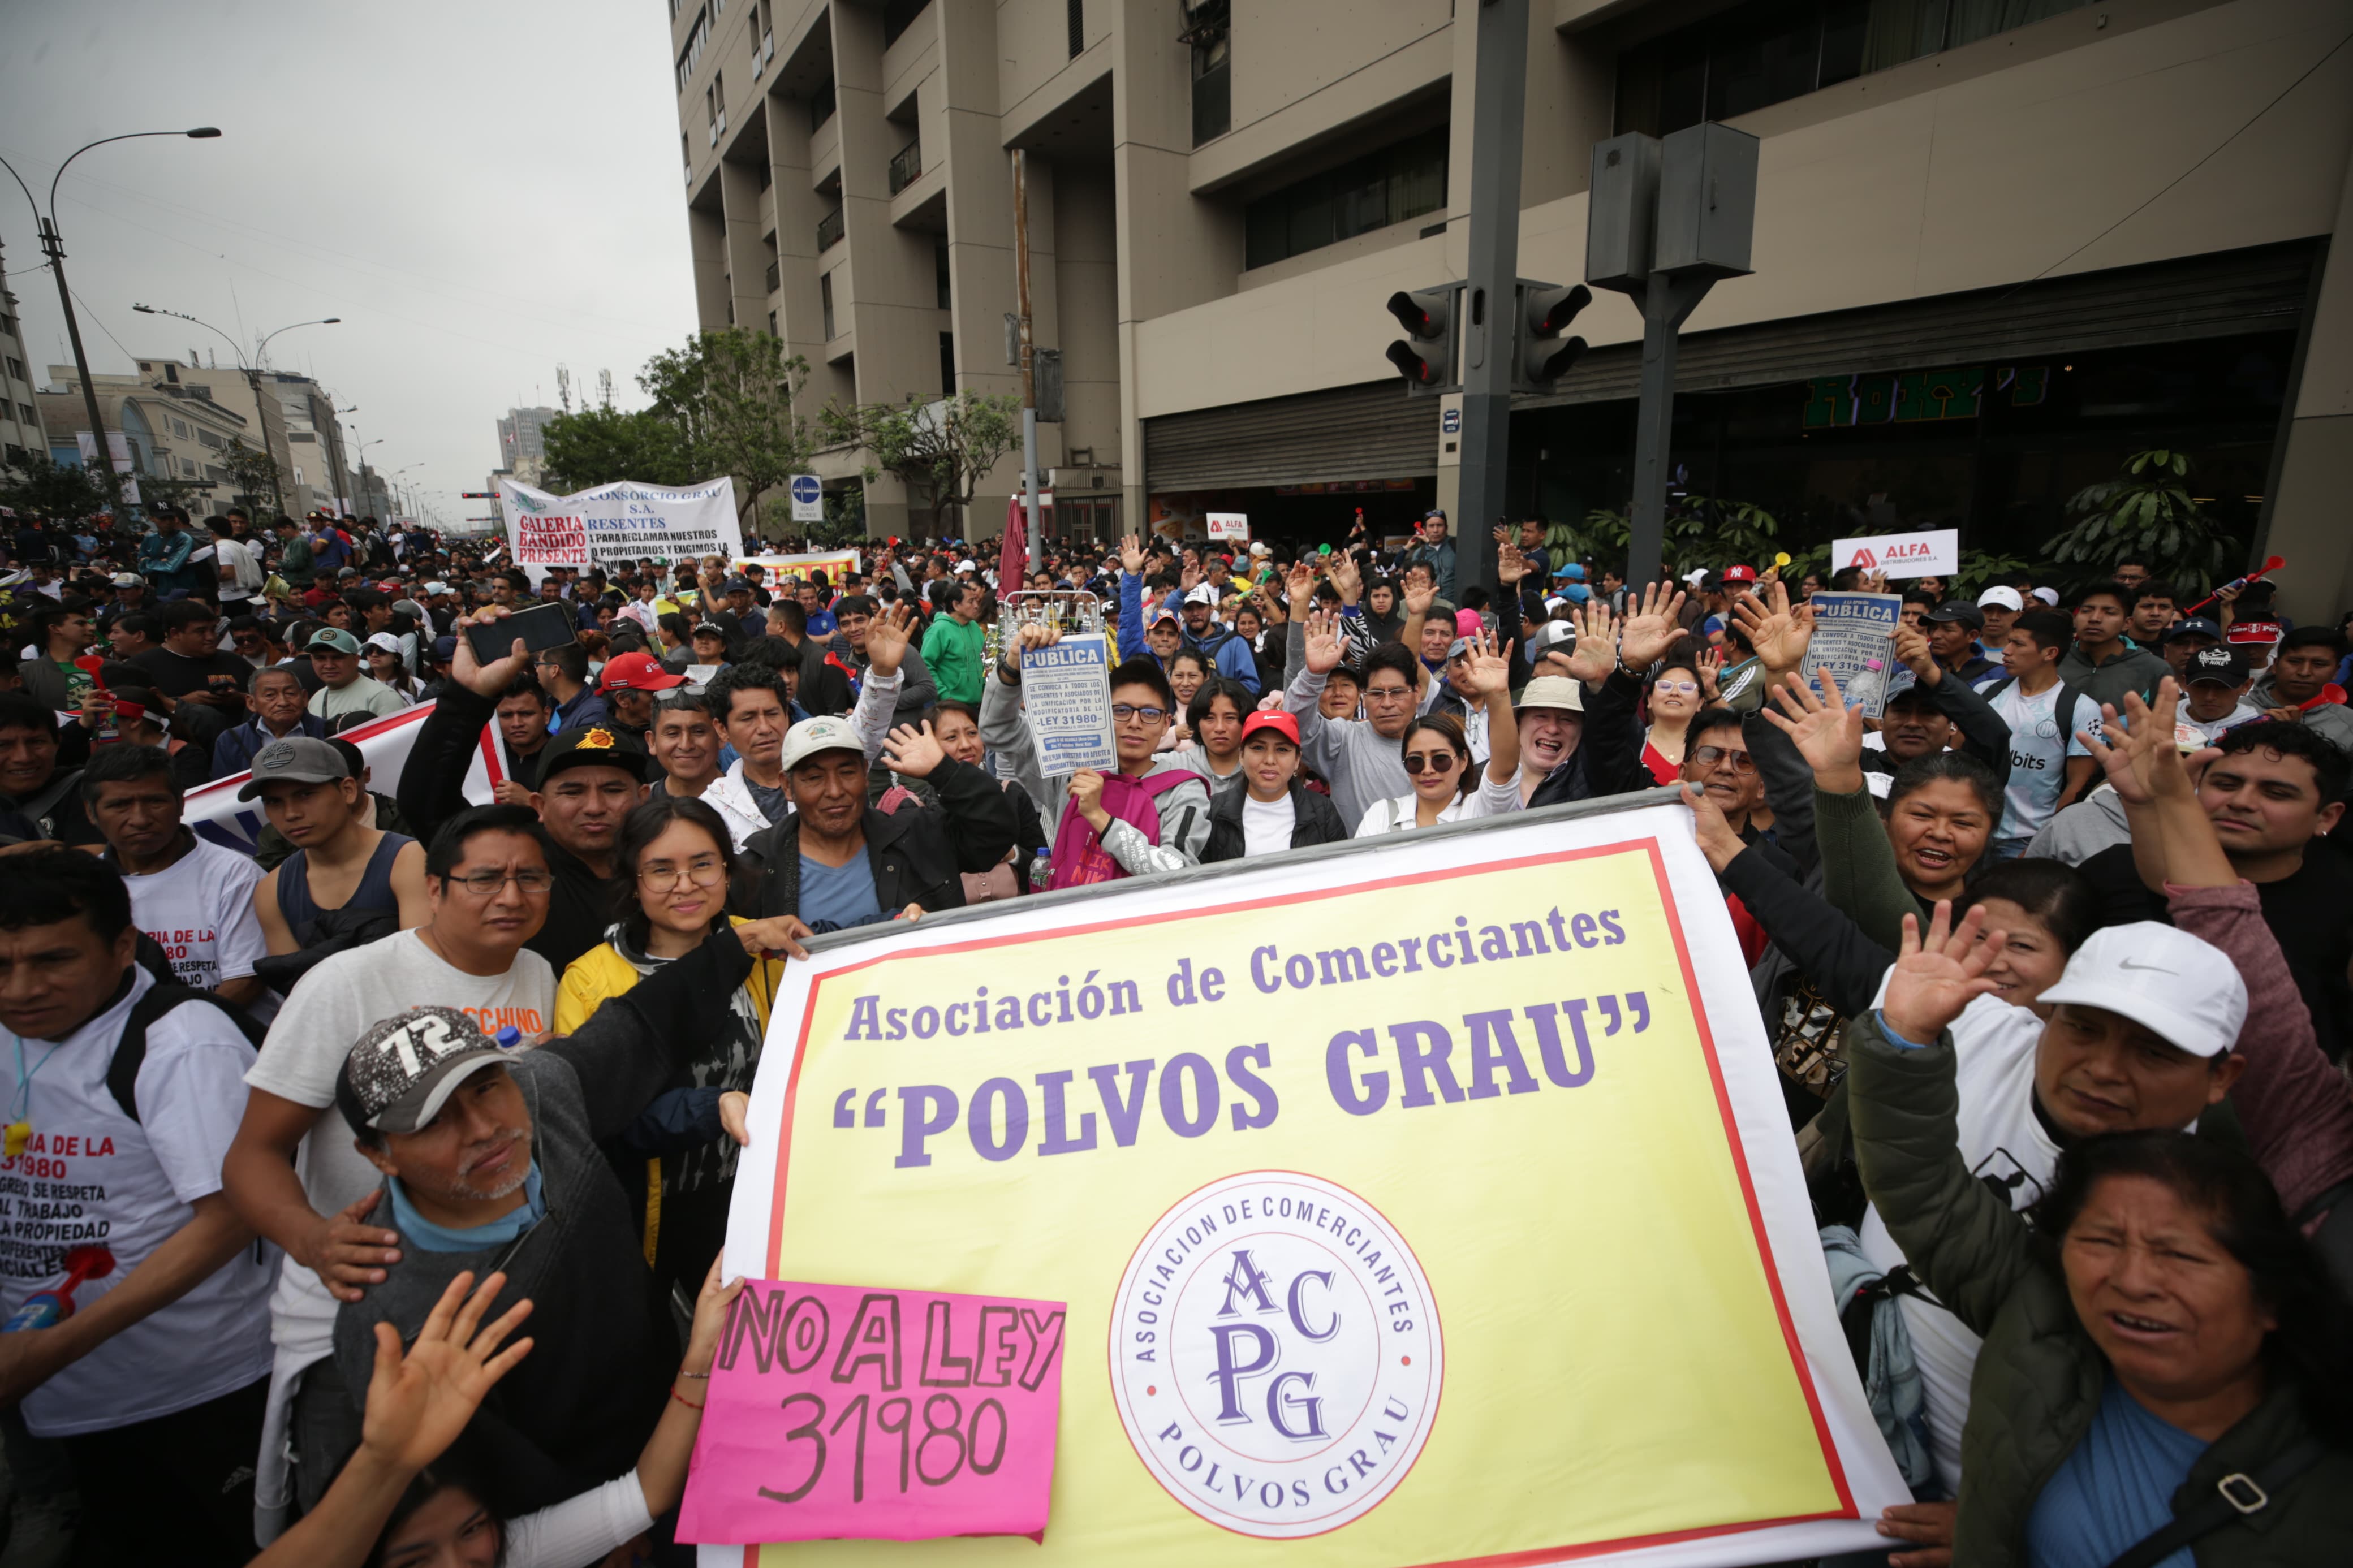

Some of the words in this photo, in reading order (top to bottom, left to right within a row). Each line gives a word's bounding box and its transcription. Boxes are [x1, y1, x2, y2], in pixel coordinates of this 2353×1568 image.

[681, 488, 721, 500] GRAU
[630, 504, 654, 513] S.A.
[520, 515, 584, 533] GALERIA
[588, 517, 666, 530] RESENTES
[519, 531, 585, 547] BANDIDO
[597, 533, 620, 543] PARA
[623, 532, 670, 542] RECLAMAR
[671, 530, 717, 541] NUESTROS
[519, 547, 587, 563] PRESENTE
[601, 545, 665, 556] PROPIETARIOS
[666, 545, 672, 554] Y
[674, 543, 716, 554] EXIGIMOS
[718, 542, 729, 551] LA
[1886, 543, 1930, 558] ALFA
[1730, 567, 1742, 577] NY
[1847, 641, 1877, 650] ASOCIADOS
[1023, 649, 1099, 667] PUBLICA
[1839, 662, 1867, 671] 3198
[1033, 707, 1080, 716] MODIFICATORIA
[2011, 750, 2046, 770] bits
[174, 930, 194, 943] DE
[199, 929, 215, 943] LA
[179, 960, 218, 973] RESPETA
[844, 969, 1143, 1041] Asociación
[1166, 957, 1226, 1007] de
[1250, 905, 1626, 994] Comerciantes
[379, 1015, 466, 1077] 72
[833, 1042, 1279, 1169] “POLVOS
[1326, 991, 1650, 1116] GRAU”
[53, 1135, 79, 1156] DE
[86, 1137, 115, 1157] LA
[33, 1182, 49, 1198] SE
[51, 1183, 105, 1201] RESPETA
[18, 1200, 83, 1220] TRABAJO
[0, 1221, 11, 1236] A
[15, 1220, 110, 1241] PROPIEDAD
[1136, 1214, 1217, 1362] ASOCIACION
[1223, 1199, 1253, 1225] DE
[1262, 1196, 1413, 1333] COMERCIANTES
[718, 1285, 830, 1375] NO
[830, 1293, 902, 1392] A
[919, 1301, 1066, 1392] LEY
[757, 1392, 1007, 1504] 31980
[1158, 1420, 1311, 1509] POLVOS
[1324, 1395, 1410, 1494] GRAU
